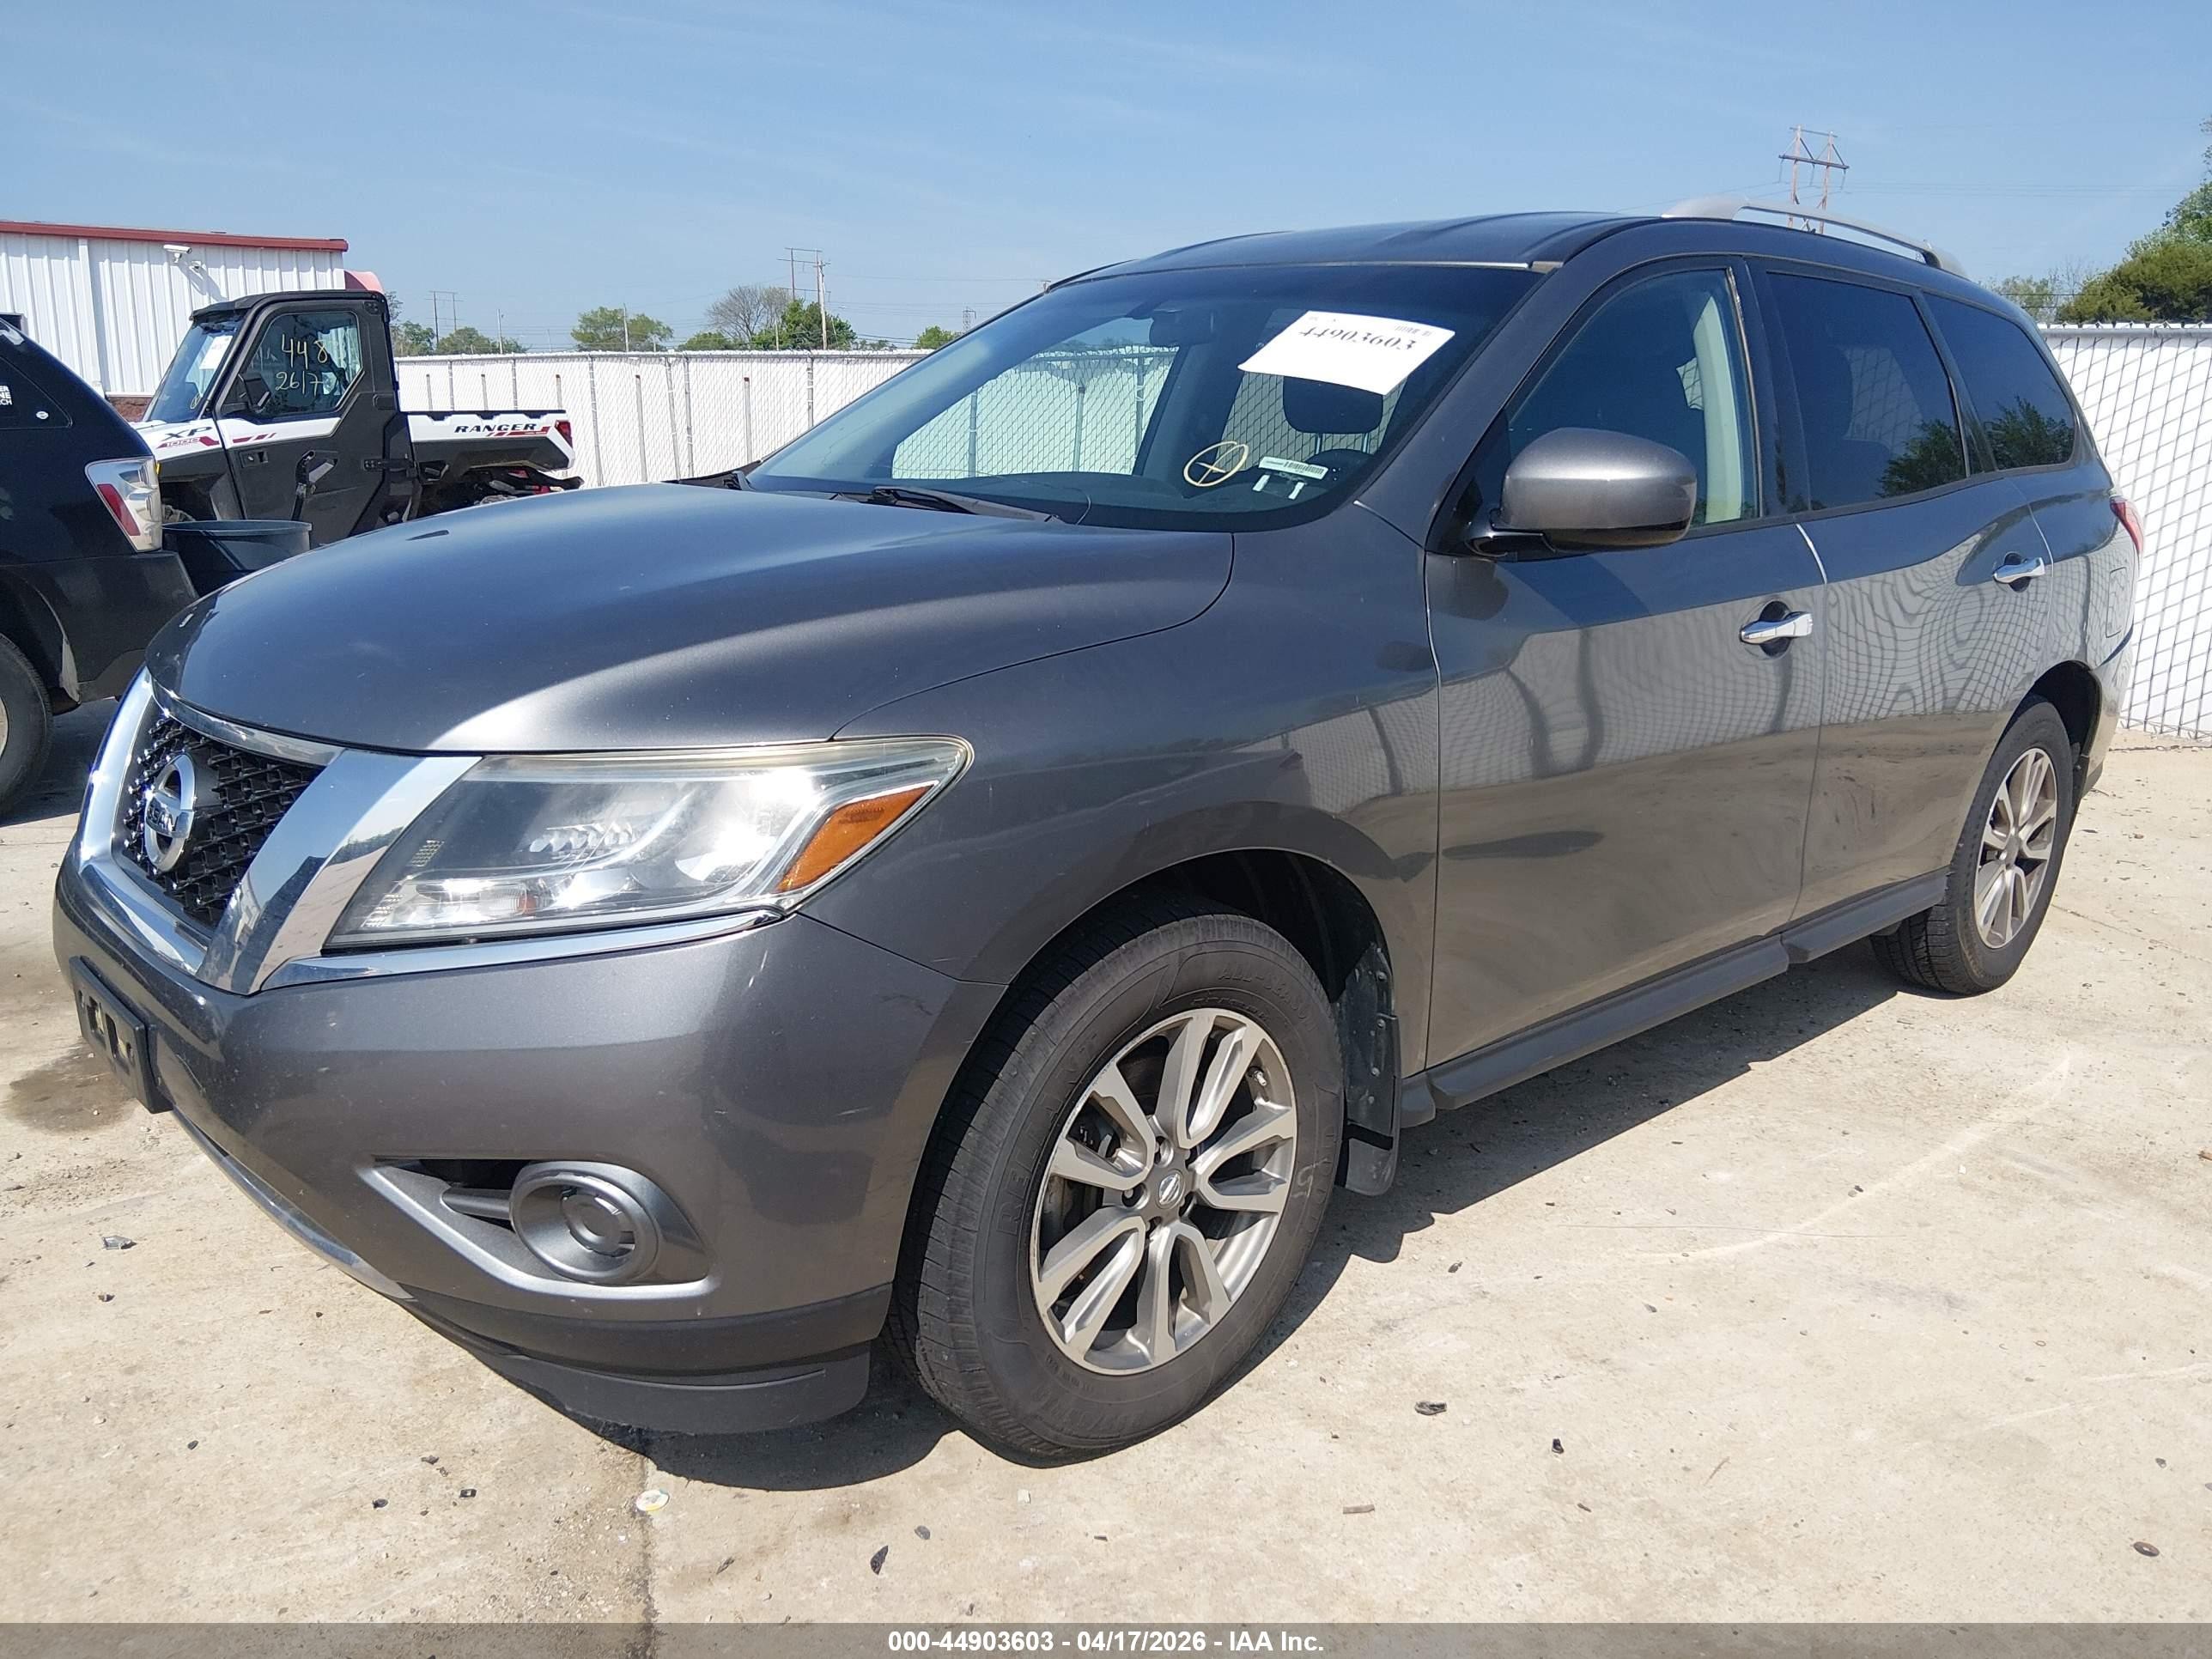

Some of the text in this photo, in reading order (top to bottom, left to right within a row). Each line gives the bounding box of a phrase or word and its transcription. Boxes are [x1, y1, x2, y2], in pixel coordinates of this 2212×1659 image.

[1298, 326, 1417, 349] 44903603
[275, 370, 324, 397] 2617
[161, 426, 213, 441] XP
[453, 423, 537, 433] RANGER
